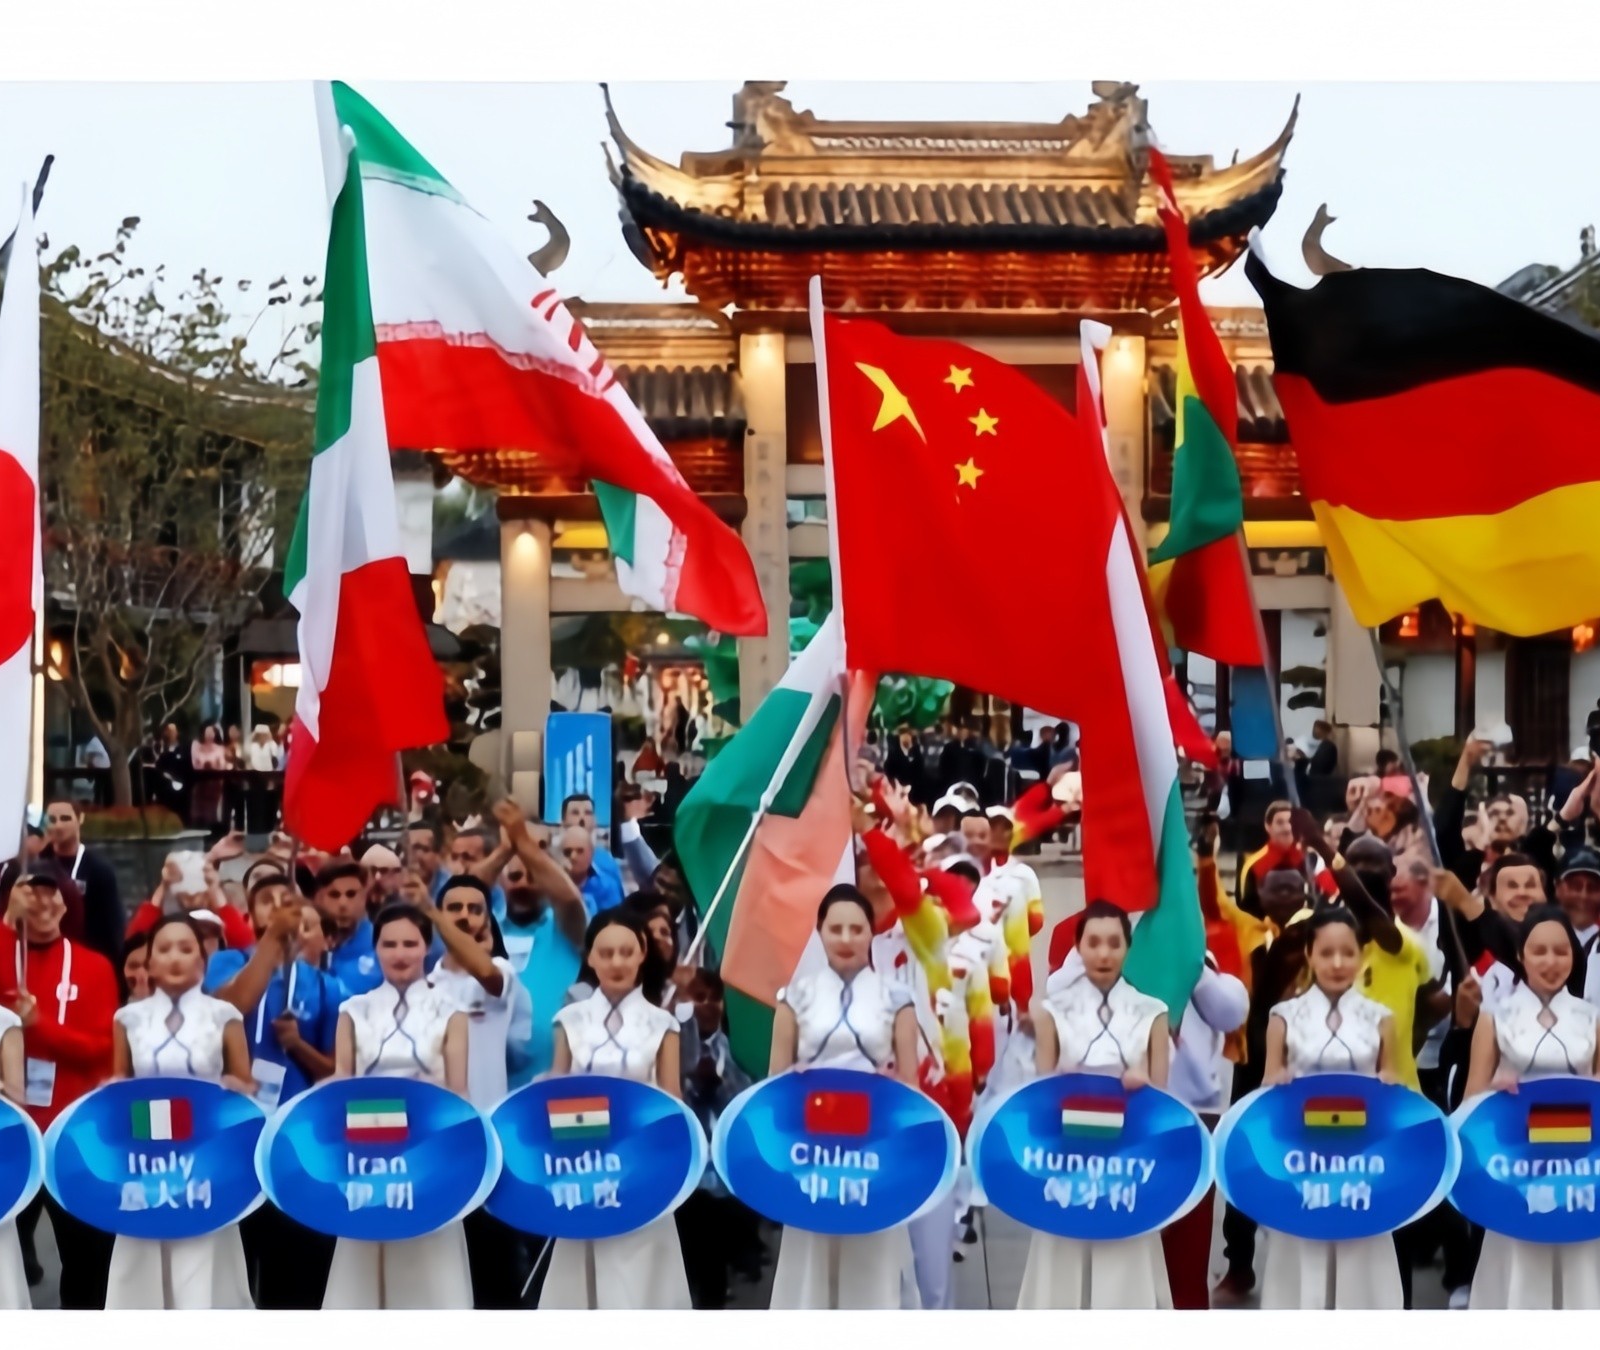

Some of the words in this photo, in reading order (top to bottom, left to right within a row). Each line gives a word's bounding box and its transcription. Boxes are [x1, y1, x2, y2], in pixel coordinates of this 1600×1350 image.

[127, 1151, 195, 1180] Italy
[347, 1151, 408, 1176] Iran
[543, 1149, 622, 1177] India
[790, 1142, 880, 1171] China
[1023, 1146, 1156, 1184] Hungary
[1283, 1149, 1386, 1175] Ghana
